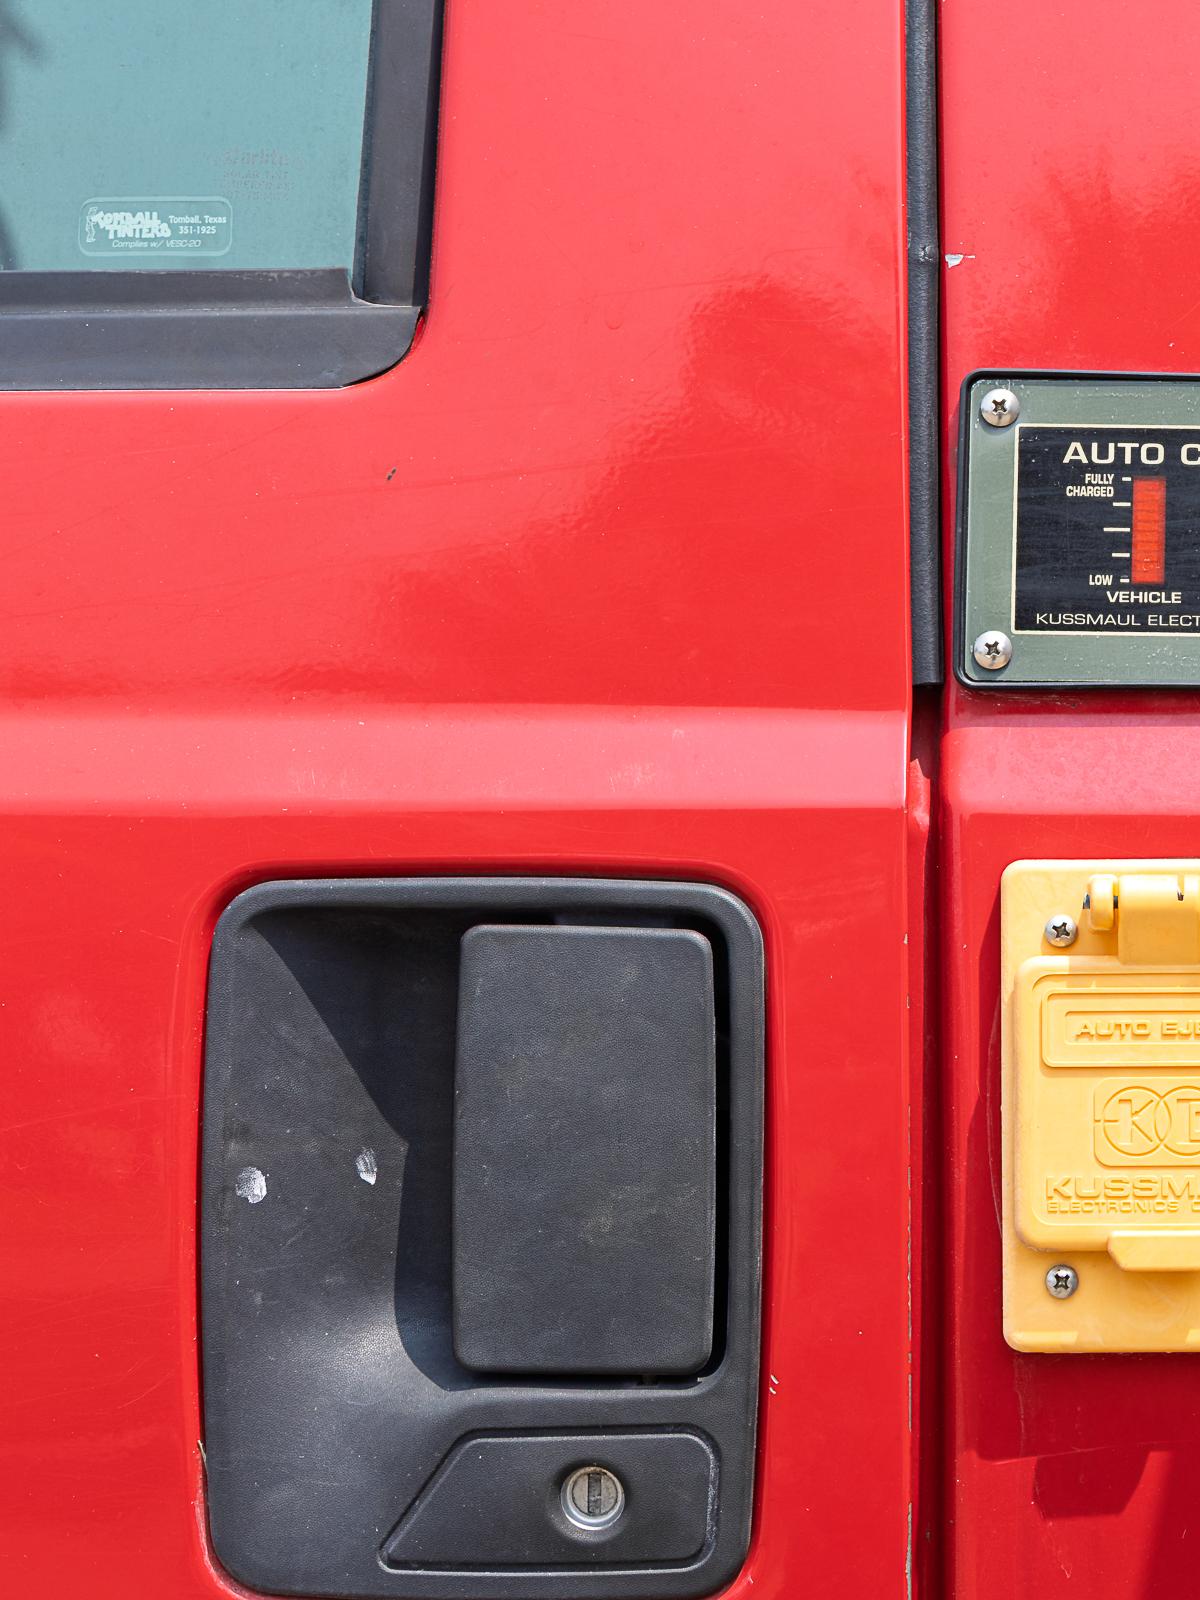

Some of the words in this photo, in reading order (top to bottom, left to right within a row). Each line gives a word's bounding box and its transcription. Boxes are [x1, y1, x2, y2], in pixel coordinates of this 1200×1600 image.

[204, 215, 227, 224] Texas
[178, 226, 217, 235] 351-1925
[112, 239, 148, 249] Complies
[1062, 441, 1165, 465] AUTO
[1085, 473, 1114, 485] FULLY
[1066, 486, 1114, 497] CHARGED
[1088, 574, 1113, 586] LOW
[1106, 590, 1182, 604] VEHICLE
[1036, 613, 1141, 626] KUSSMAUL
[1075, 1019, 1151, 1040] AUTO
[1047, 1199, 1180, 1214] ELECTRONICS
